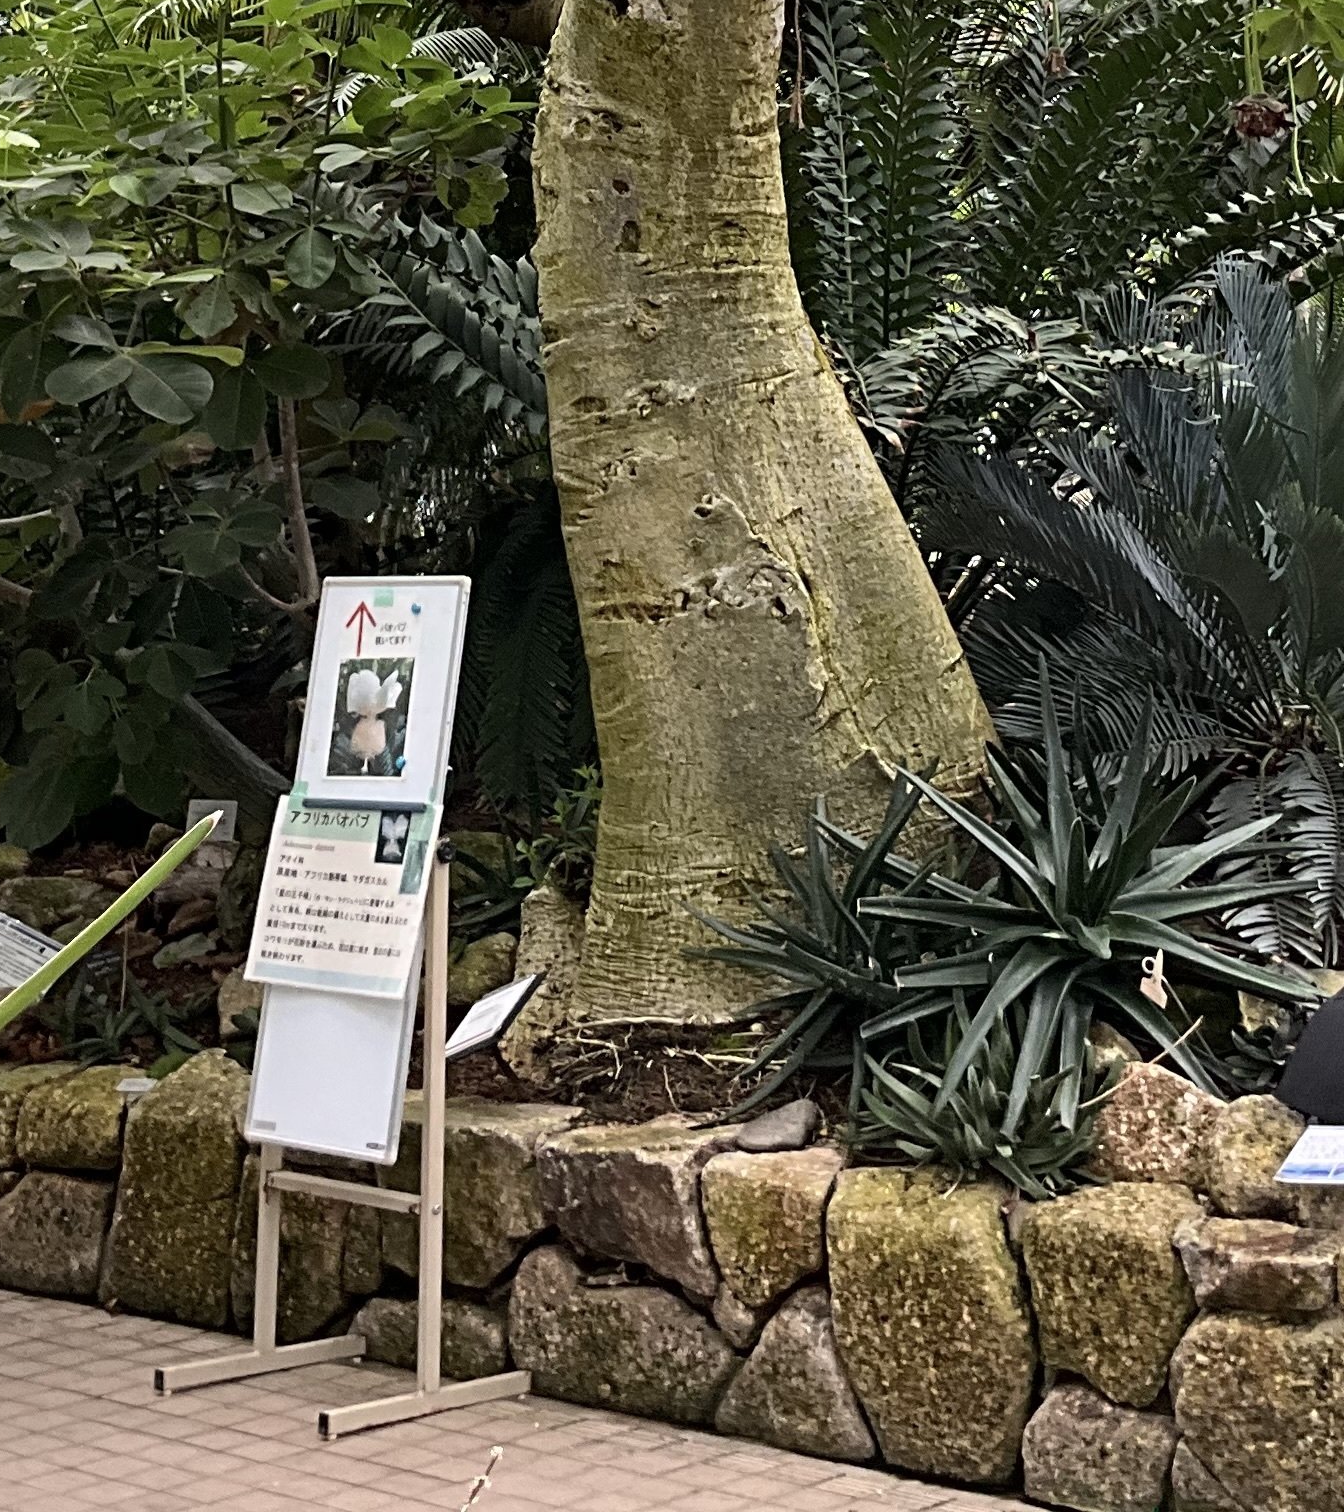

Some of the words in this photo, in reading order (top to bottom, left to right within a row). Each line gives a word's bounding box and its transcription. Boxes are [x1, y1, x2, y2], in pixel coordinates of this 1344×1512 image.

[290, 810, 371, 828] アフリカバオバブ
